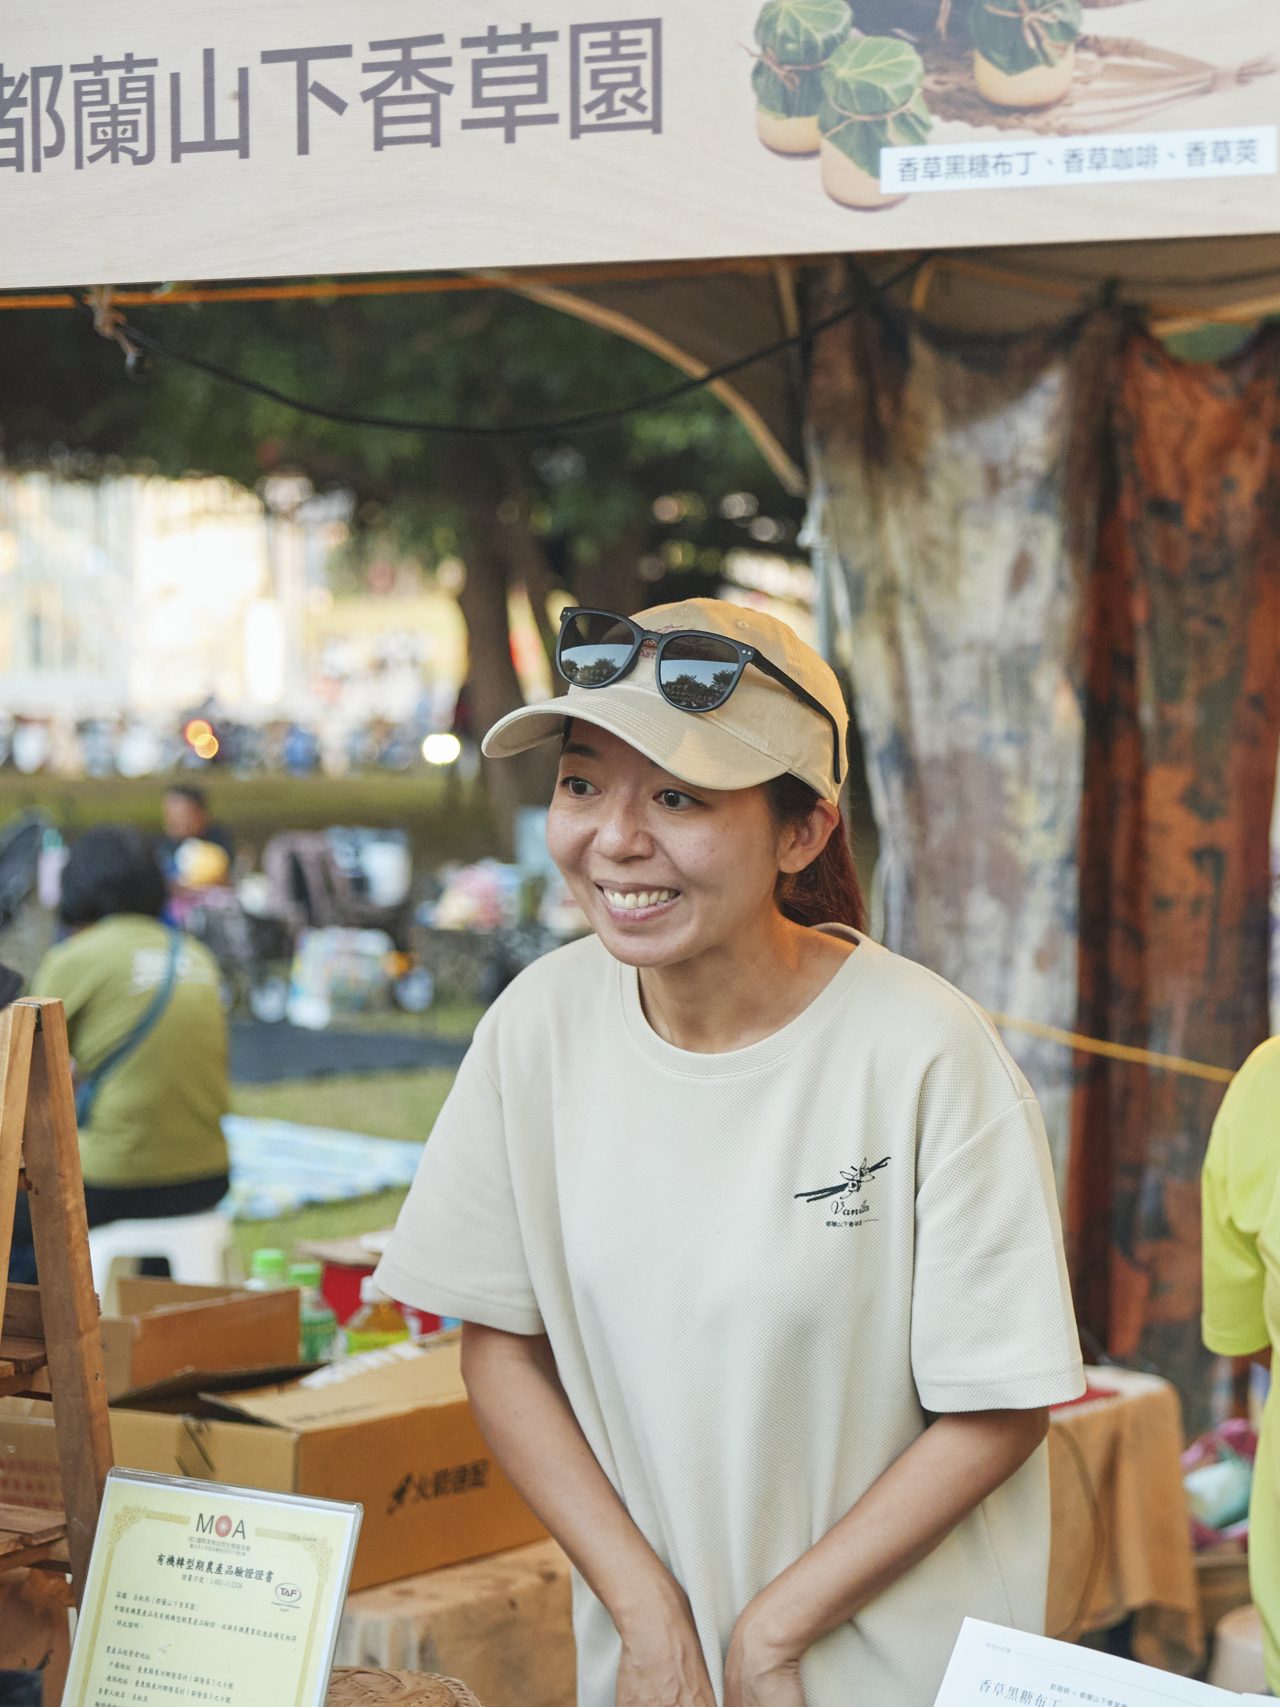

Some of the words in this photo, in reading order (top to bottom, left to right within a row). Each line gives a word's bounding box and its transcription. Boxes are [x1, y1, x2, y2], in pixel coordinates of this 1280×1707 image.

[0, 17, 663, 173] 都蘭山下香草園
